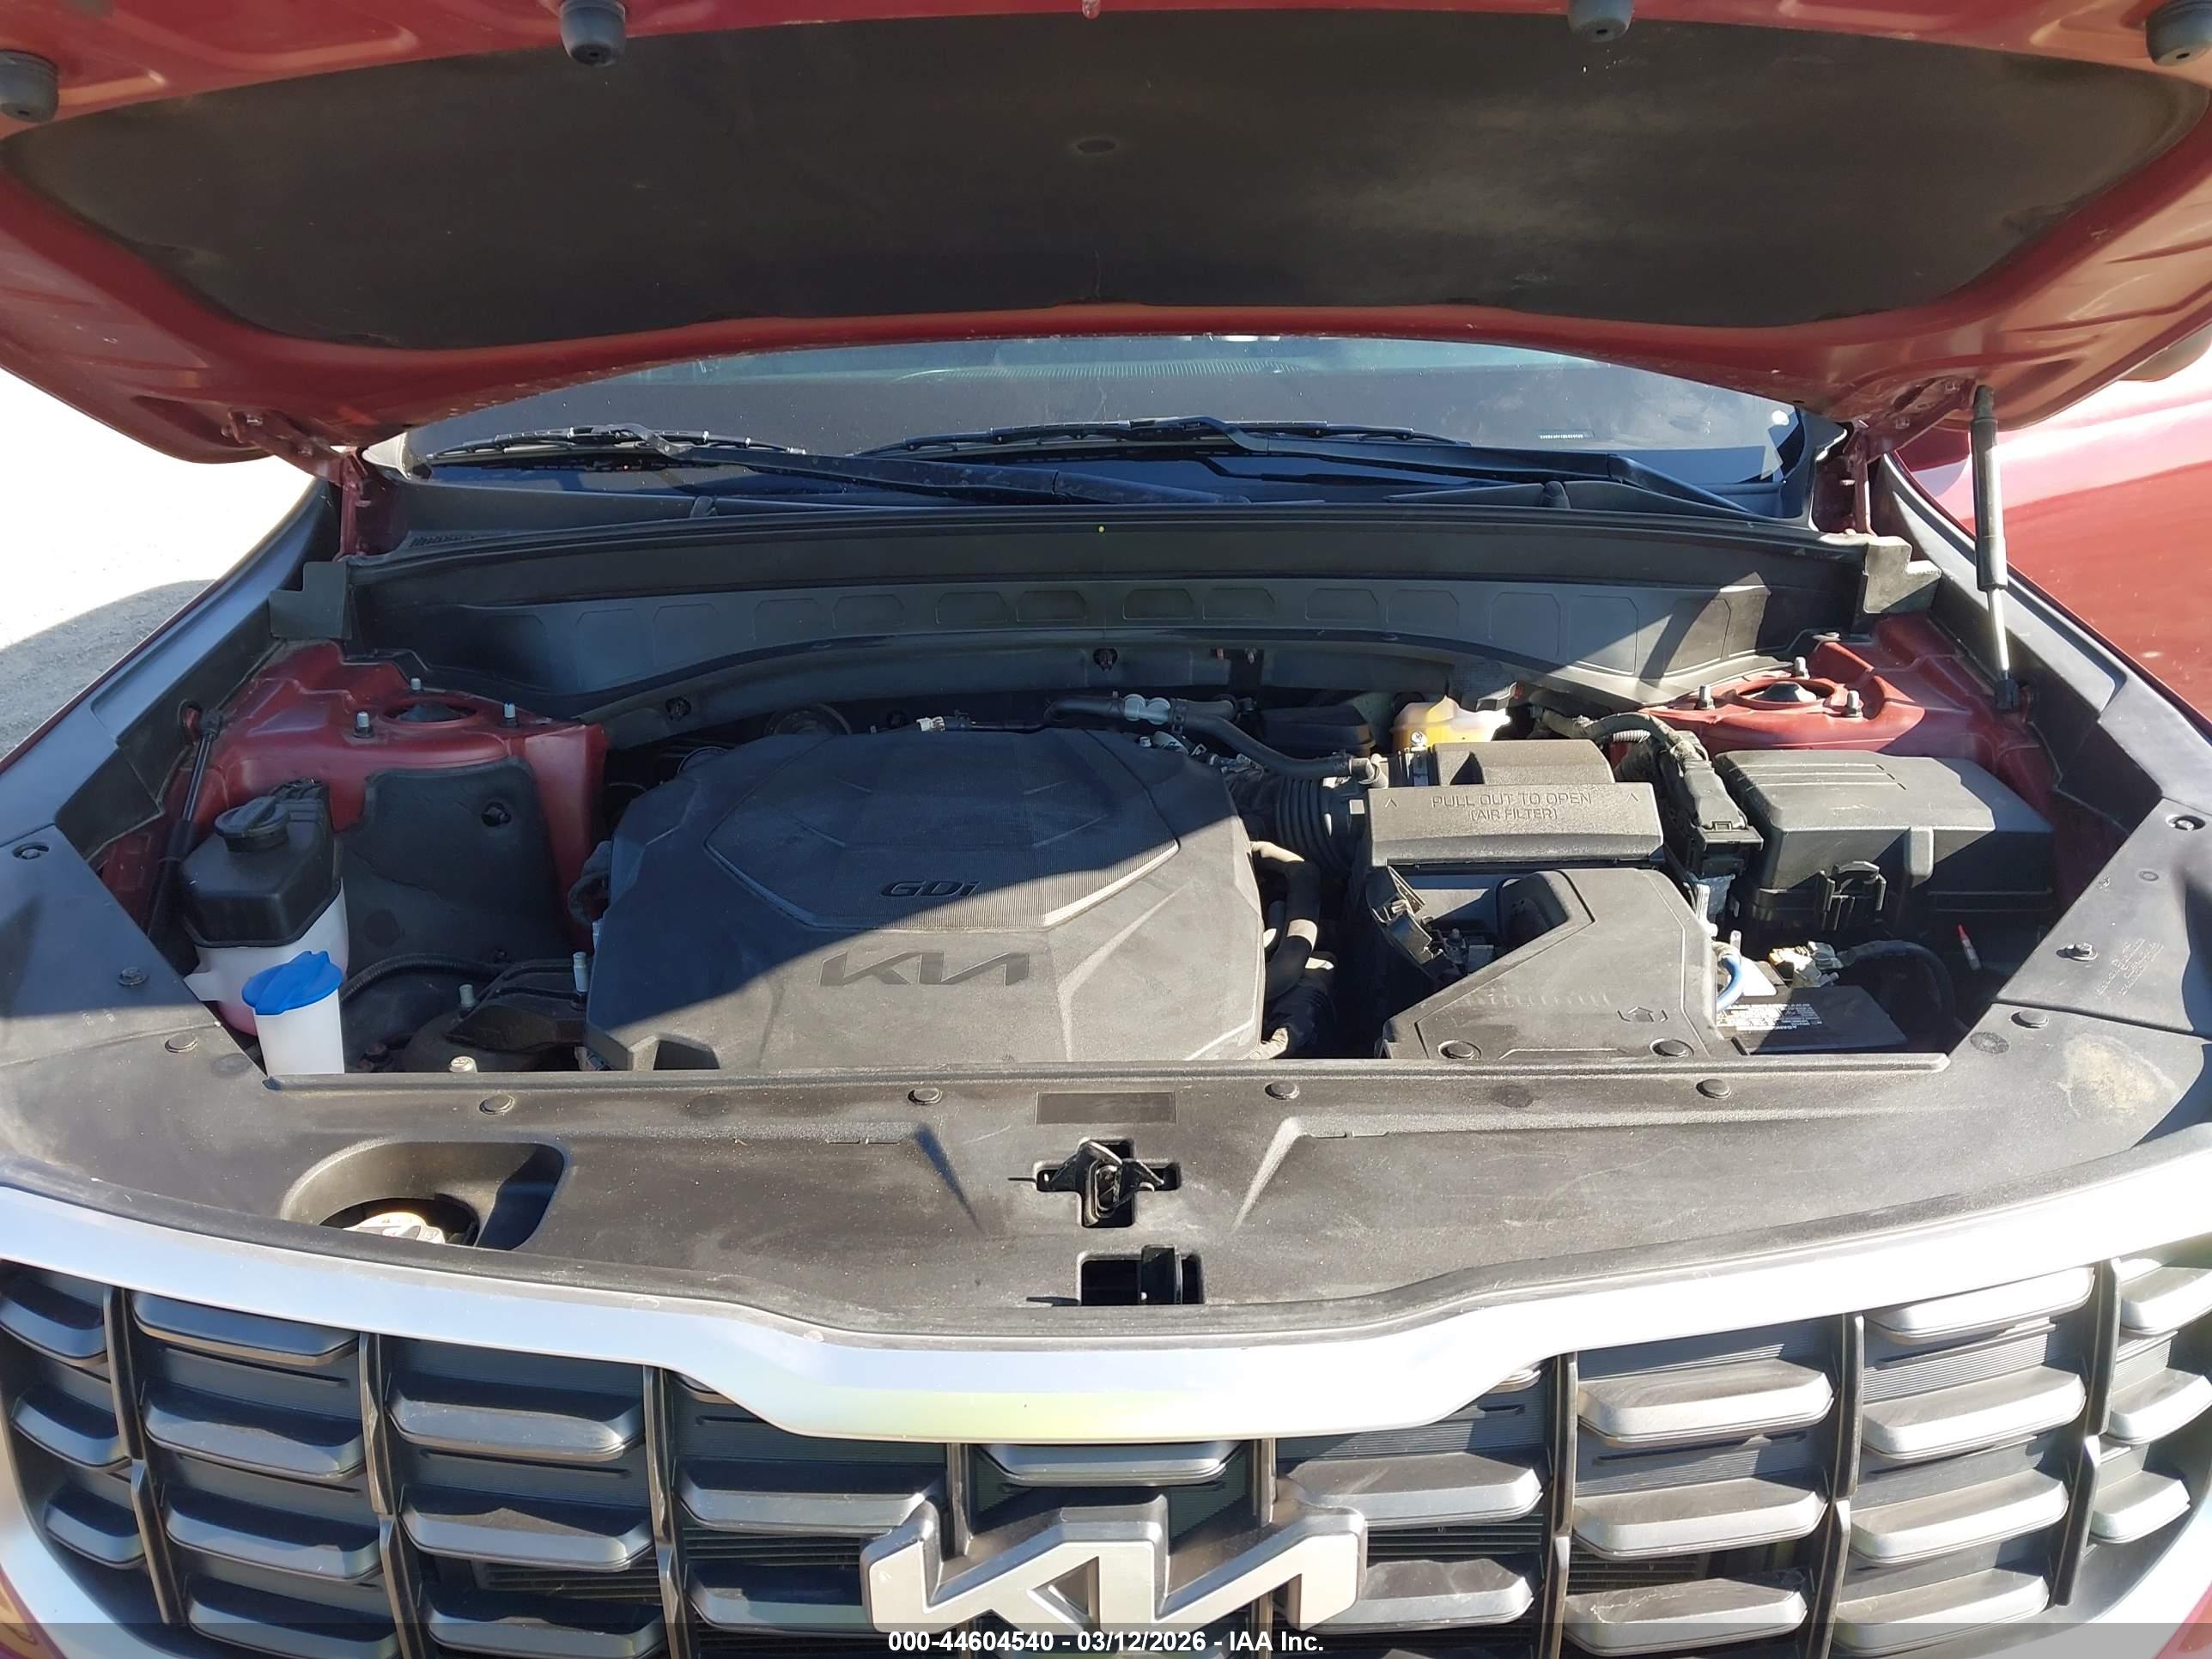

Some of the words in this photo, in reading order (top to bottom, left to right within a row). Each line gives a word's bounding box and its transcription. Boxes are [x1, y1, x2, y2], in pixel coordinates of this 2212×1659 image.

[1431, 795, 1475, 808] PULL
[1480, 793, 1513, 805] OUT
[1518, 793, 1540, 805] TO
[1546, 793, 1593, 805] OPEN
[879, 879, 981, 897] GDi
